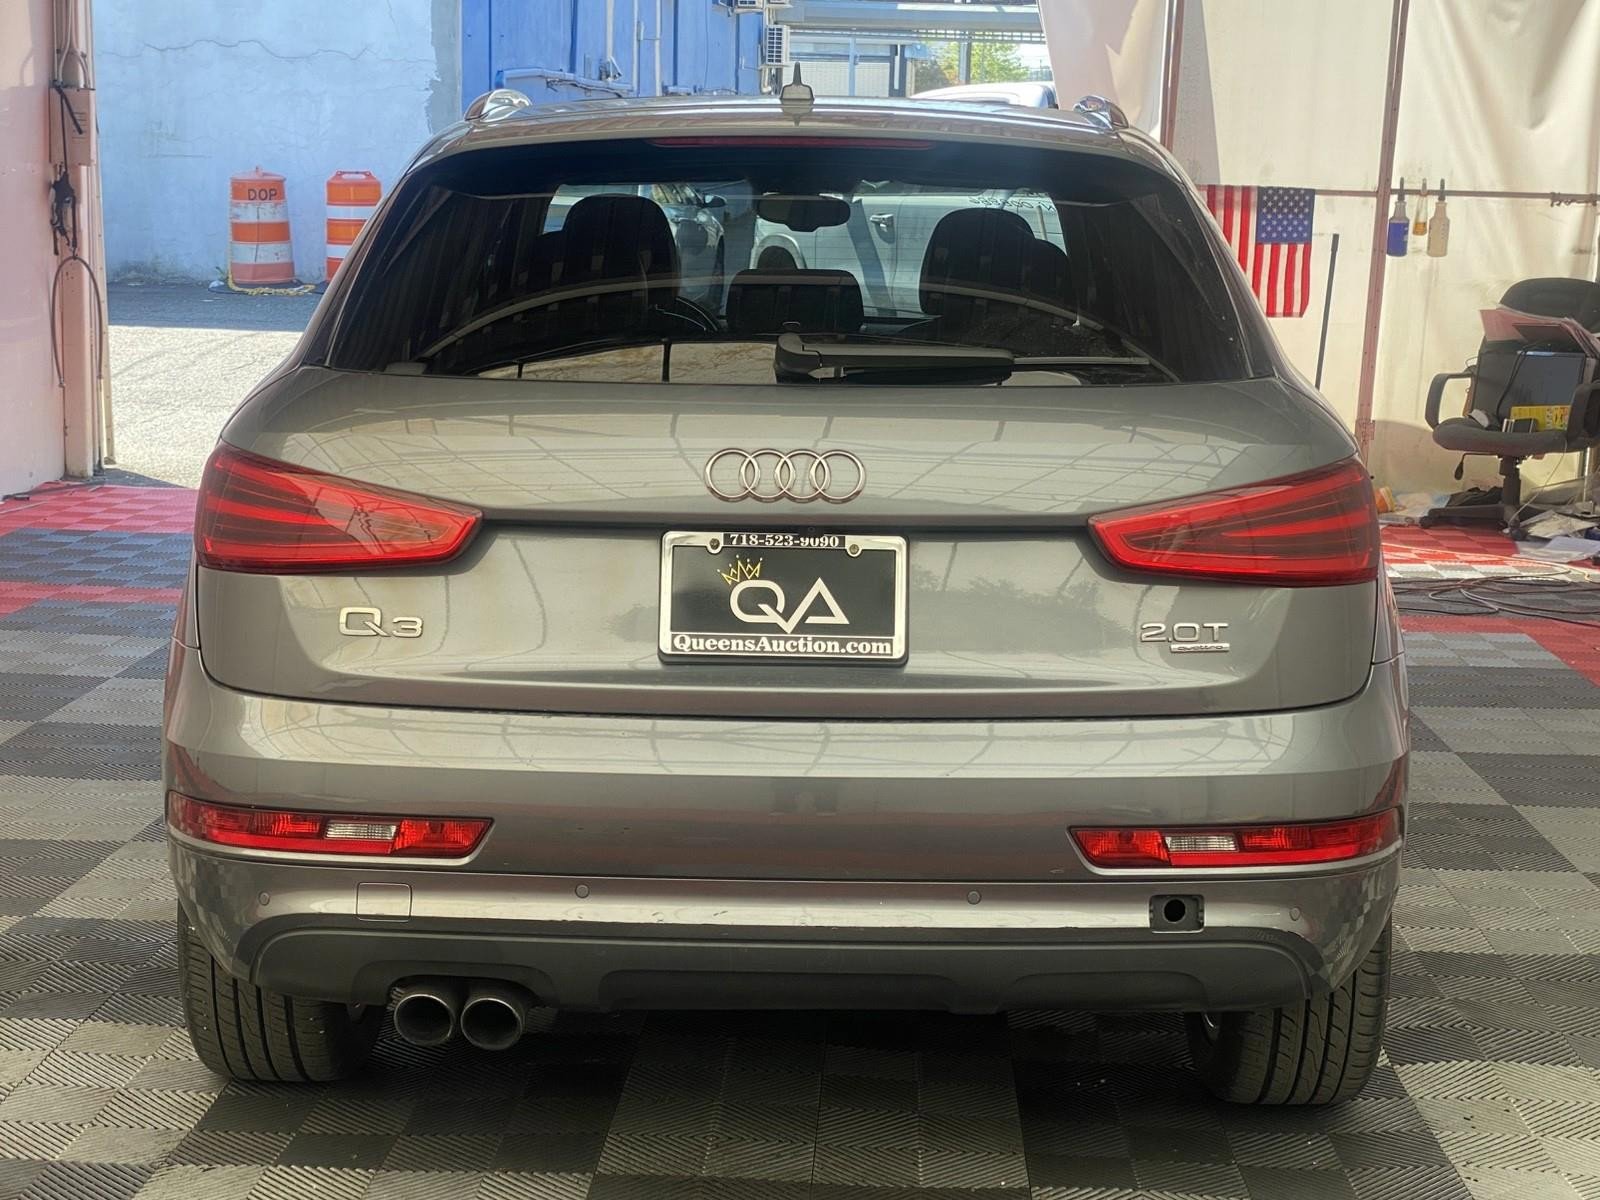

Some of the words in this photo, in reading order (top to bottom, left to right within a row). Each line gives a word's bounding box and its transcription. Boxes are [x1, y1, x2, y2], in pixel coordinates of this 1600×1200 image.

[247, 188, 277, 201] DOP
[729, 533, 840, 547] 718-523-9090
[729, 577, 850, 634] QA
[339, 606, 423, 638] Q3
[1140, 622, 1229, 642] 2.0T
[673, 634, 892, 654] QueensAuction.com
